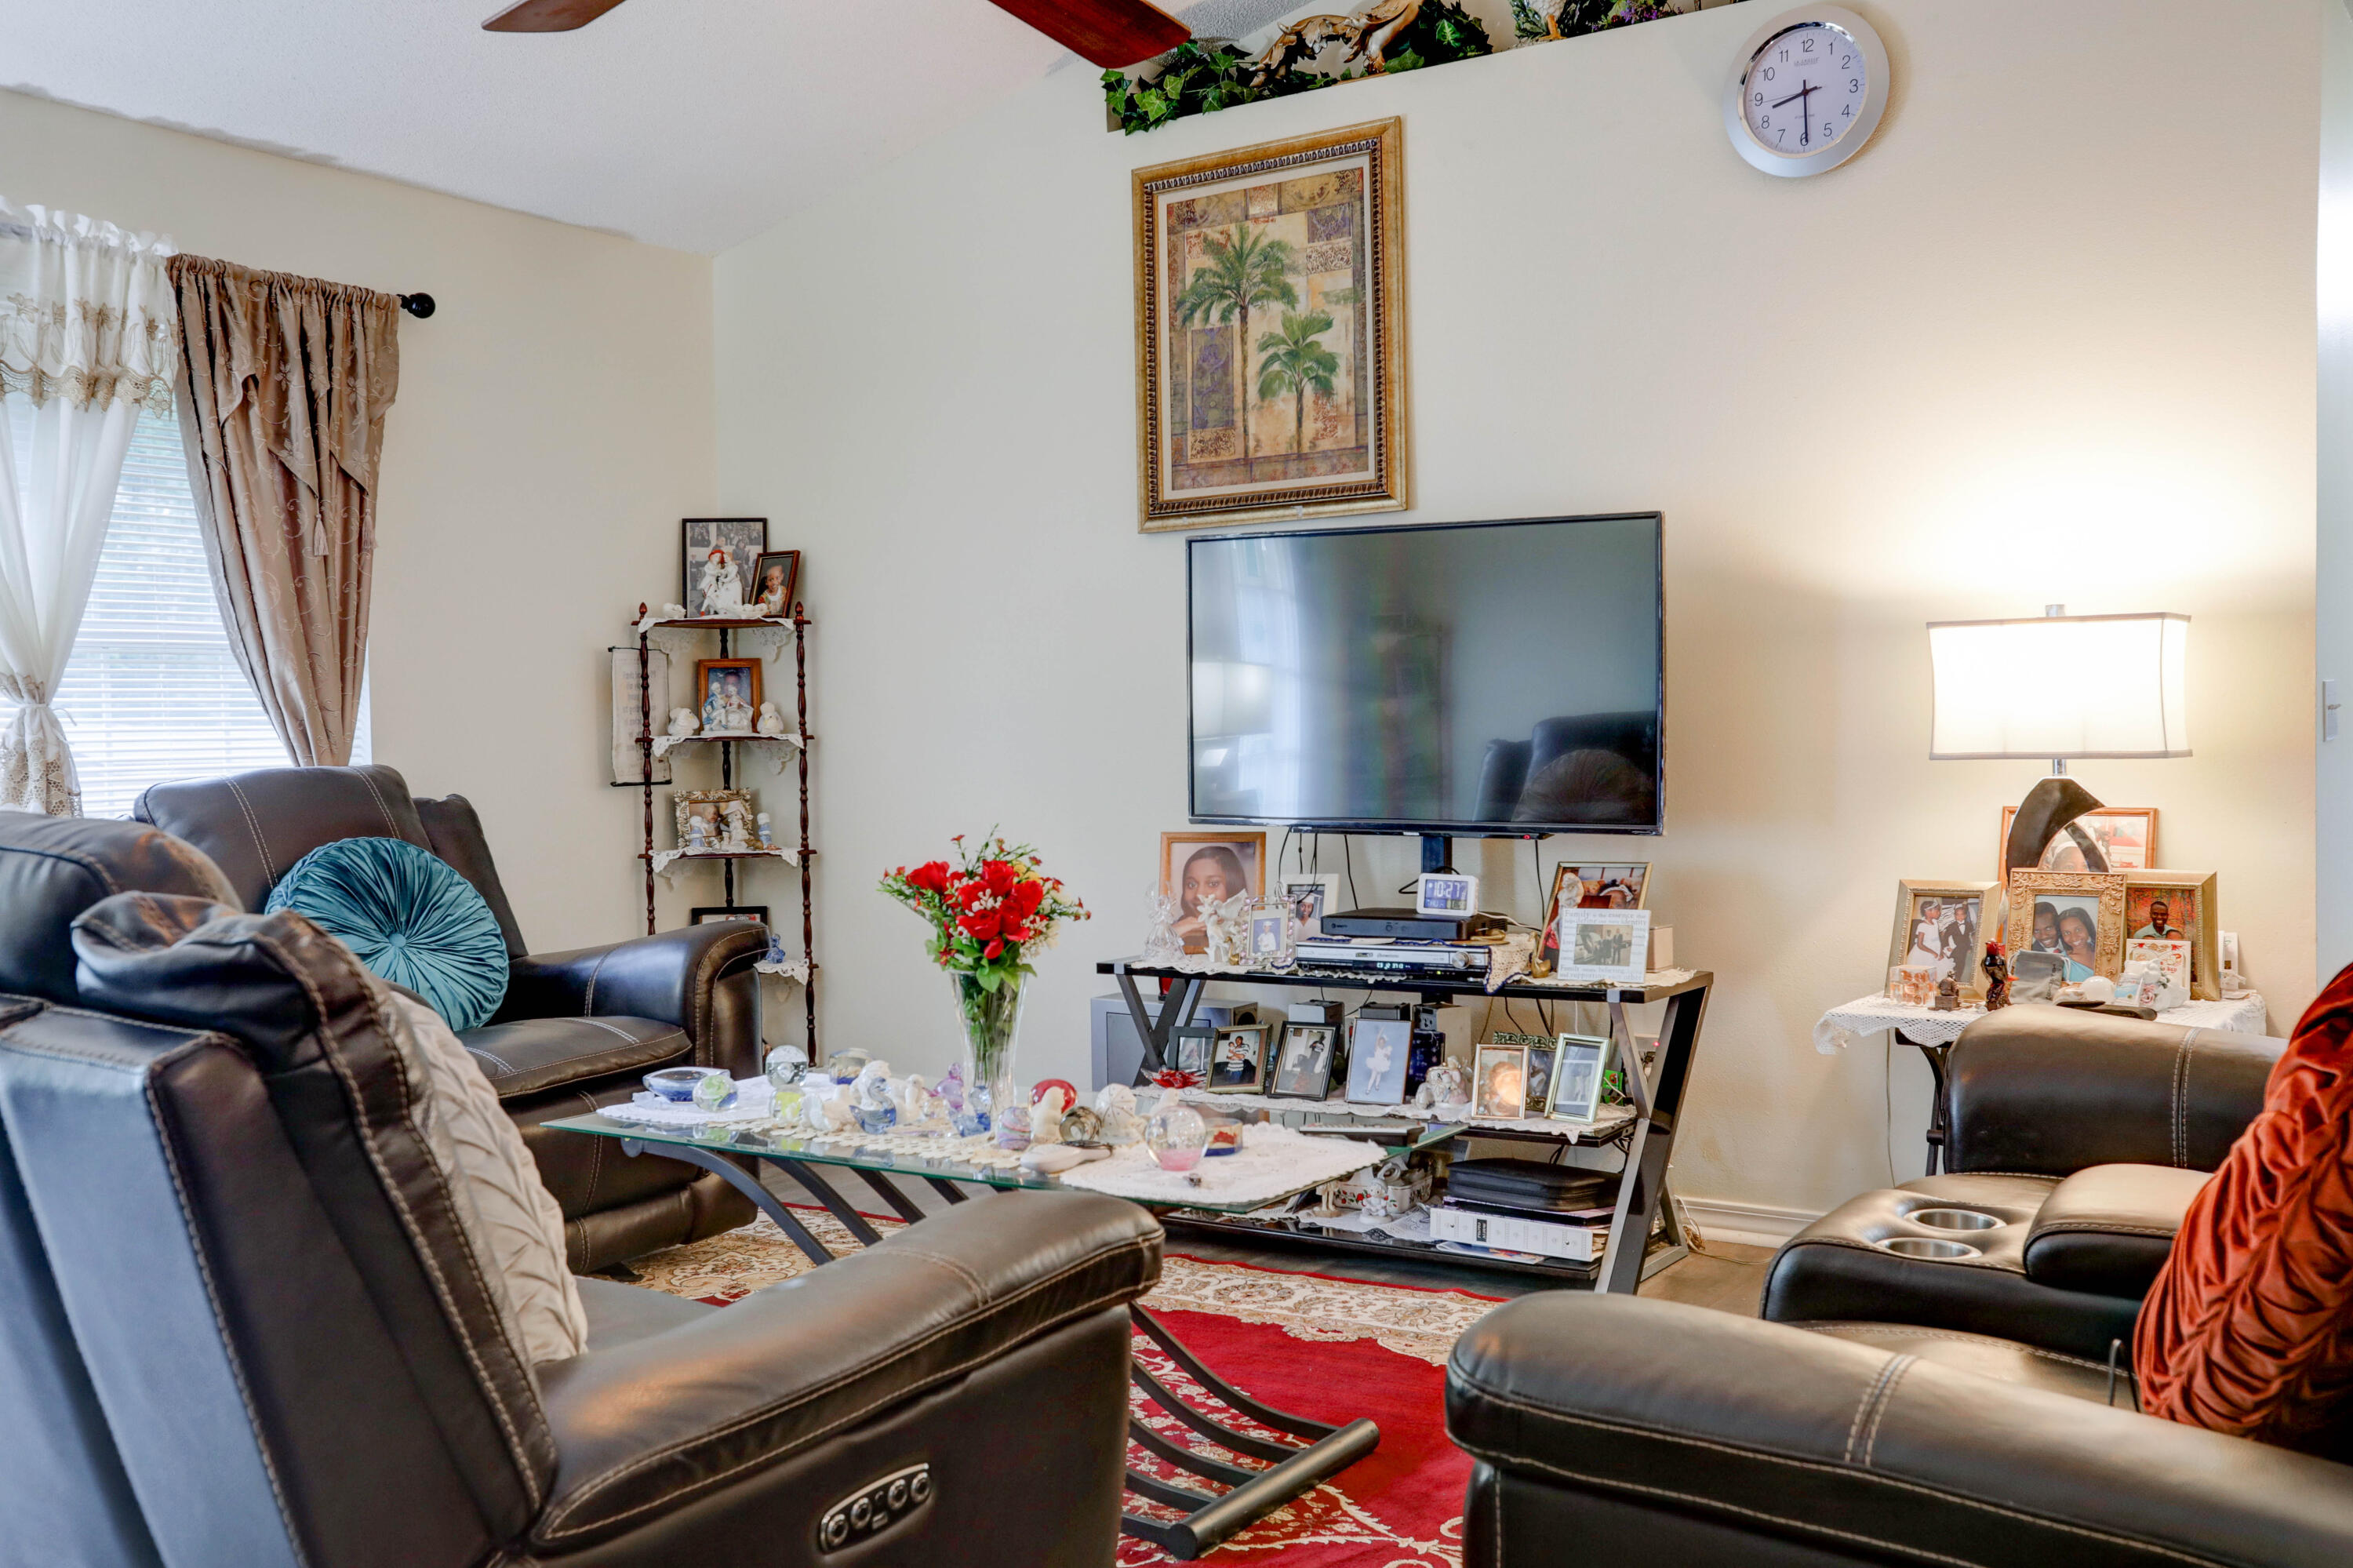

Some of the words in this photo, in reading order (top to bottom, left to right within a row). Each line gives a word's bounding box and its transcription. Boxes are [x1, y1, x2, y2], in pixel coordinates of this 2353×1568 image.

[1802, 38, 1814, 53] 12
[1827, 42, 1833, 56] 1
[1779, 49, 1789, 63] 11
[1841, 55, 1851, 70] 2
[1763, 67, 1776, 81] 10
[1849, 78, 1859, 93] 3
[1755, 93, 1763, 107] 9
[1842, 104, 1850, 118] 4
[1761, 115, 1770, 129] 8
[1777, 129, 1786, 143] 7
[1823, 122, 1833, 137] 5
[1800, 132, 1809, 147] 6
[1565, 909, 1589, 919] Family
